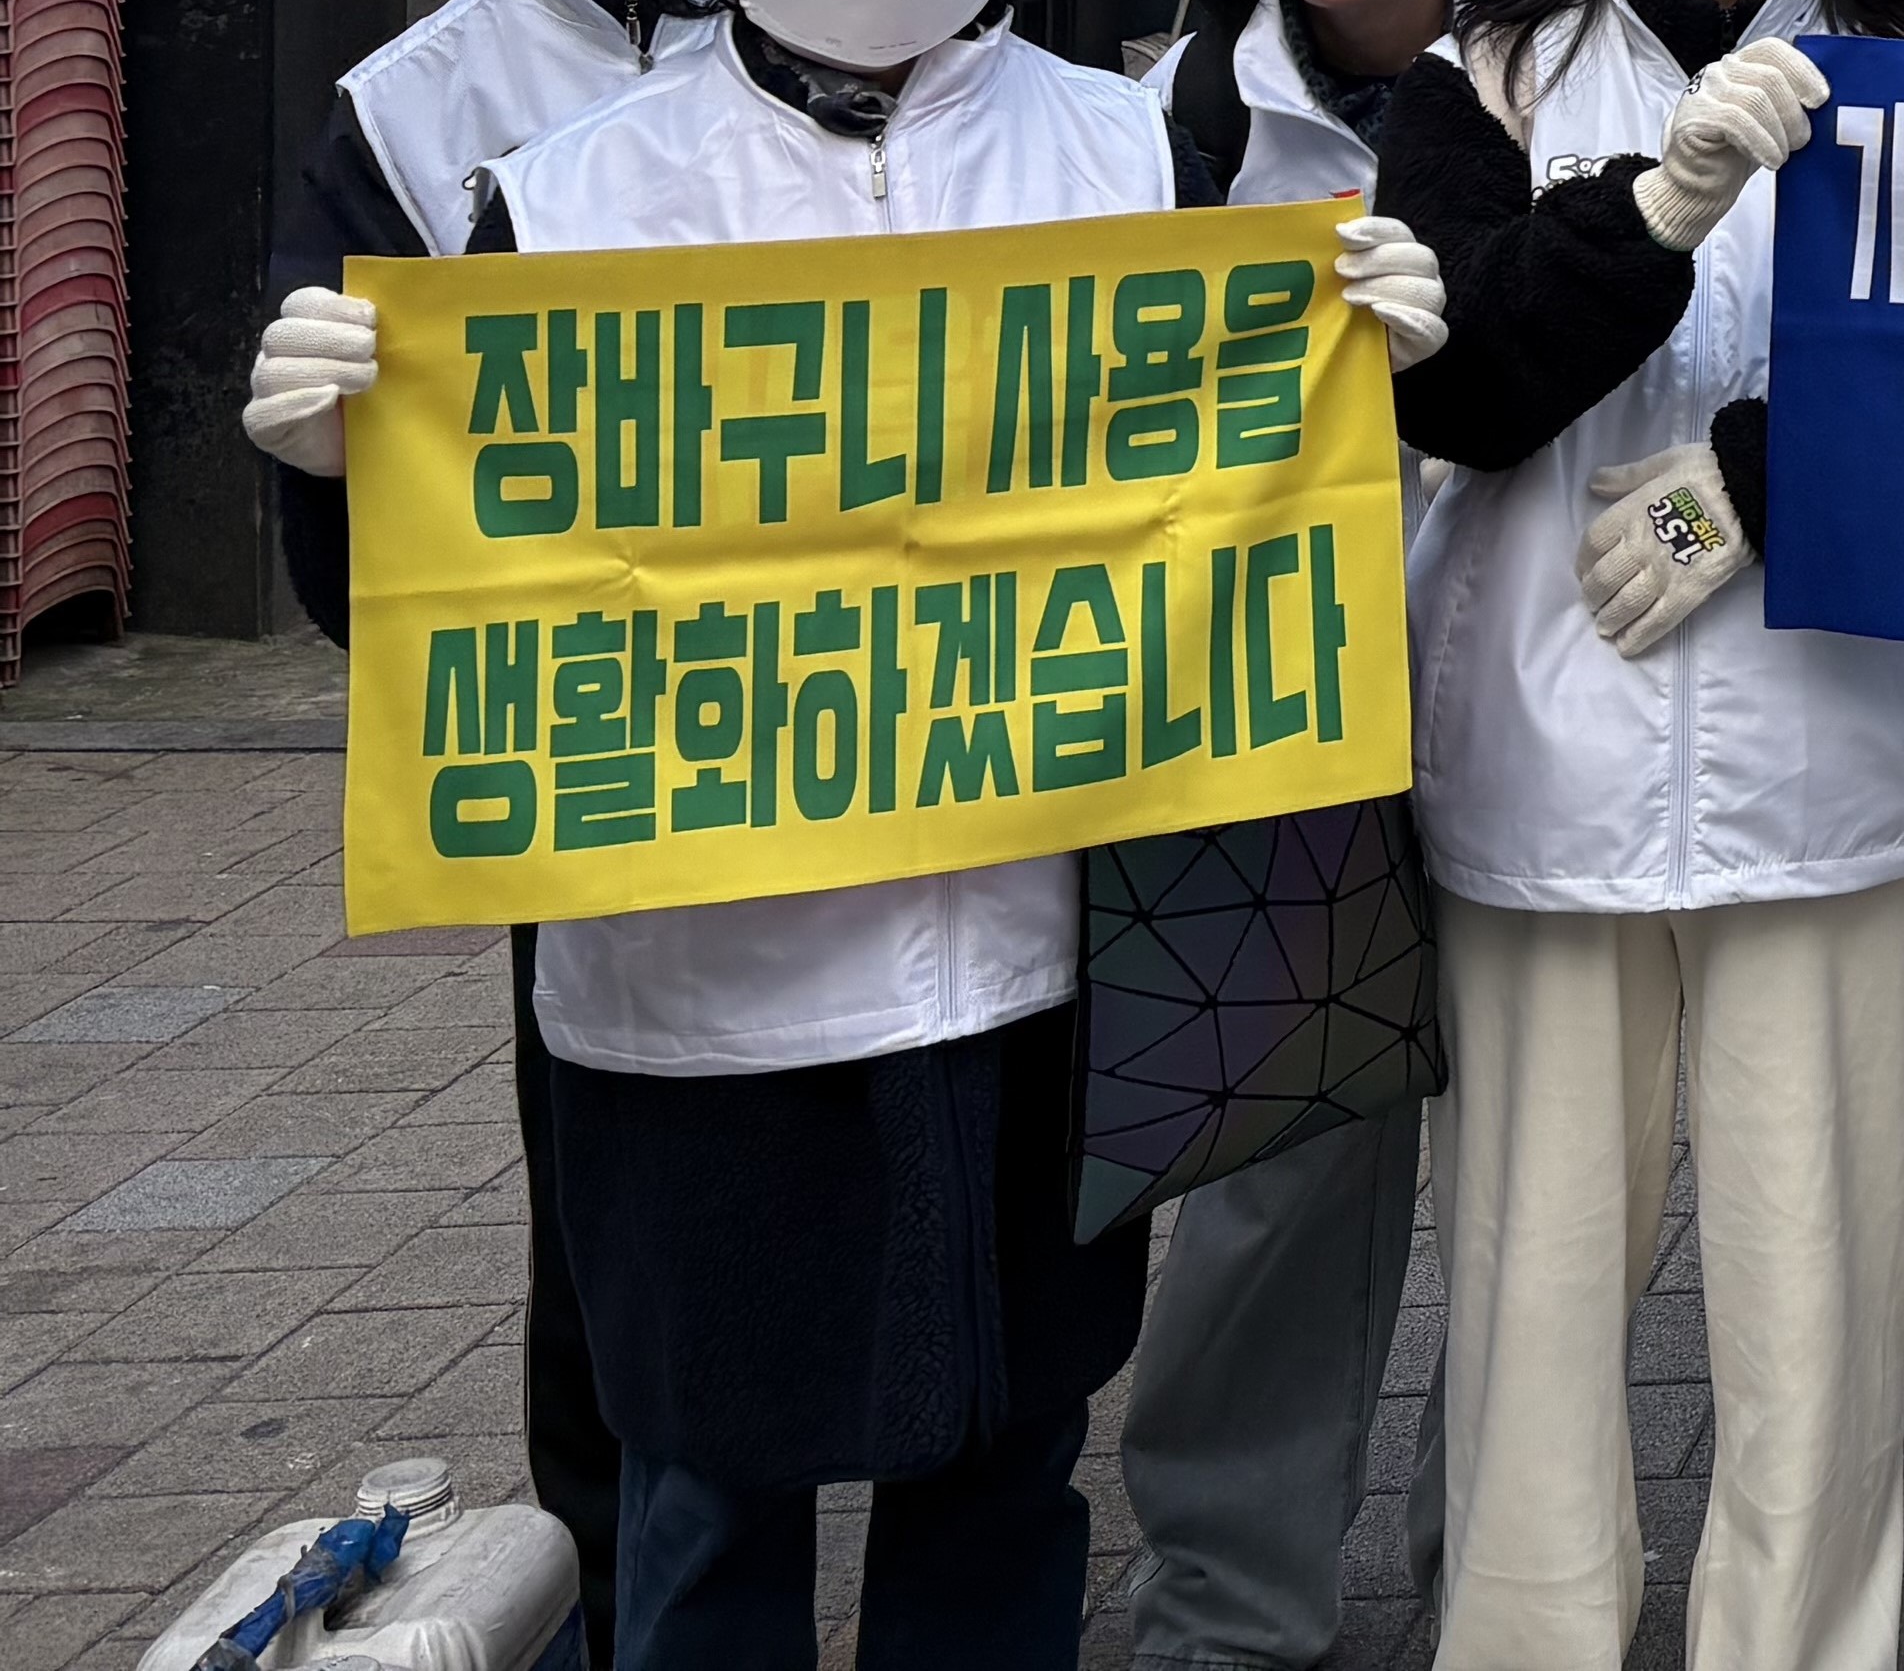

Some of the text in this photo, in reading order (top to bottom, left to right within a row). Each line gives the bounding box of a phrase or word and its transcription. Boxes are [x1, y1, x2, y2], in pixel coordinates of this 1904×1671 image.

[463, 256, 1320, 539] 장바구니 사용을
[422, 522, 1347, 863] 생활화하겠습니다
